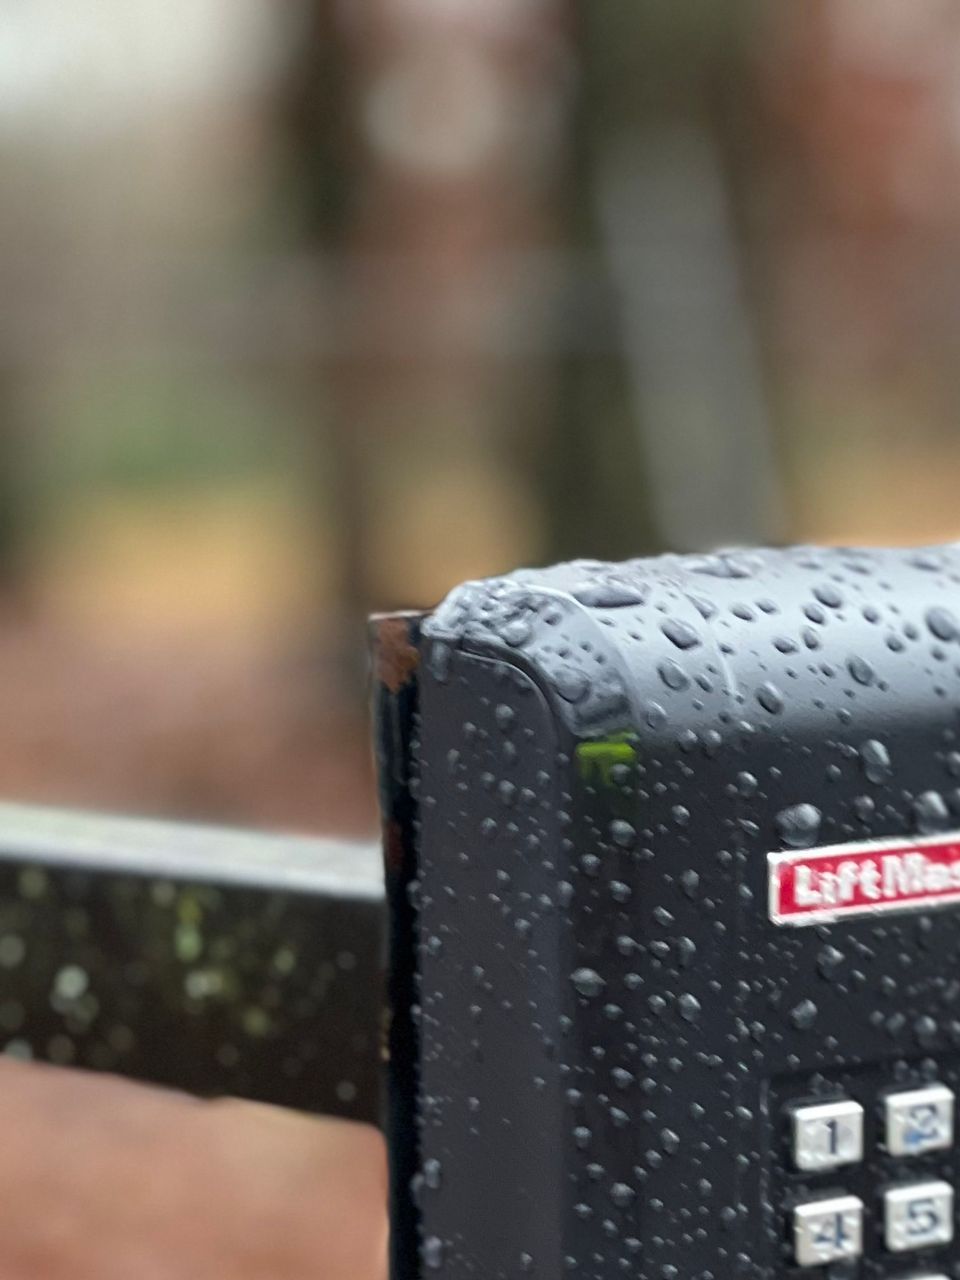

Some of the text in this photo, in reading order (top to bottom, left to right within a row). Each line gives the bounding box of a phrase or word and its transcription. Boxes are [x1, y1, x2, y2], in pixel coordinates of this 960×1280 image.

[905, 1103, 939, 1144] 2
[814, 1212, 848, 1249] 4
[906, 1198, 940, 1236] 5
